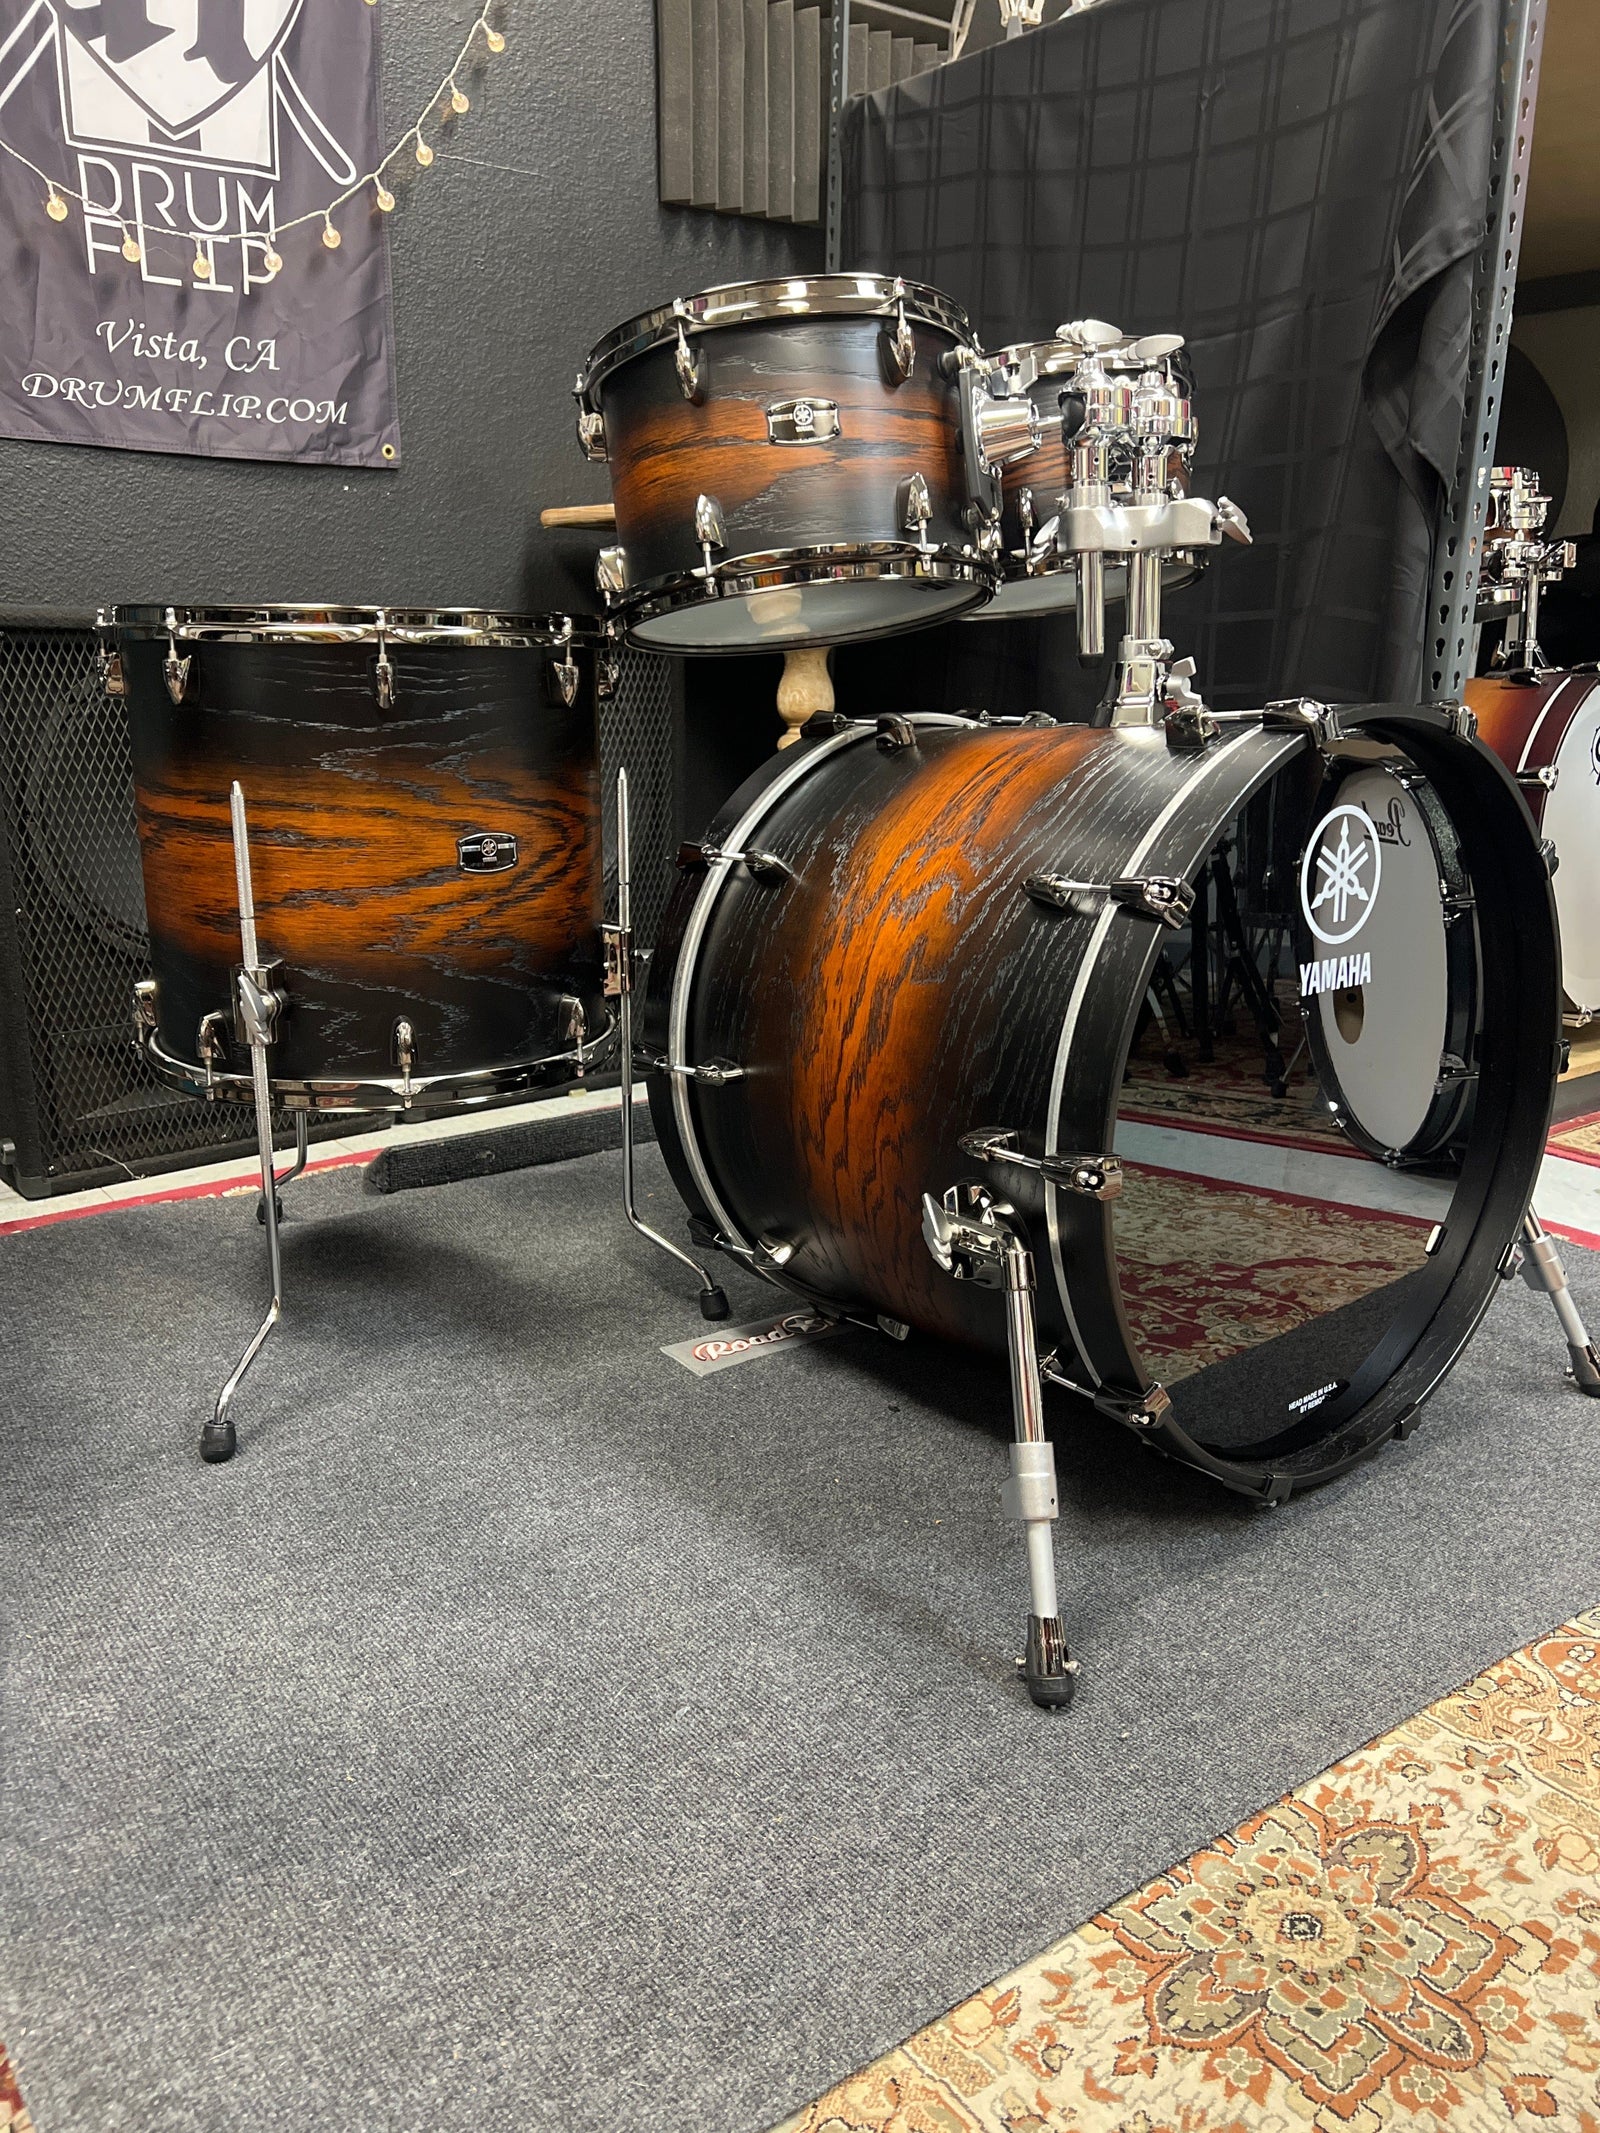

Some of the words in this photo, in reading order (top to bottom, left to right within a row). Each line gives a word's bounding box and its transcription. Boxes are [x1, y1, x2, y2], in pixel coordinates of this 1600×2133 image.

[78, 153, 277, 242] DRUM
[83, 213, 282, 295] FLIP
[95, 319, 207, 371] Vista,
[224, 335, 281, 372] CA
[21, 372, 350, 426] DRUMFLIP.COM
[1299, 952, 1372, 997] YAMAHA
[1288, 1398, 1303, 1411] HEAD
[1303, 1390, 1318, 1404] MADE
[1317, 1387, 1324, 1397] IN
[1300, 1403, 1308, 1413] BY
